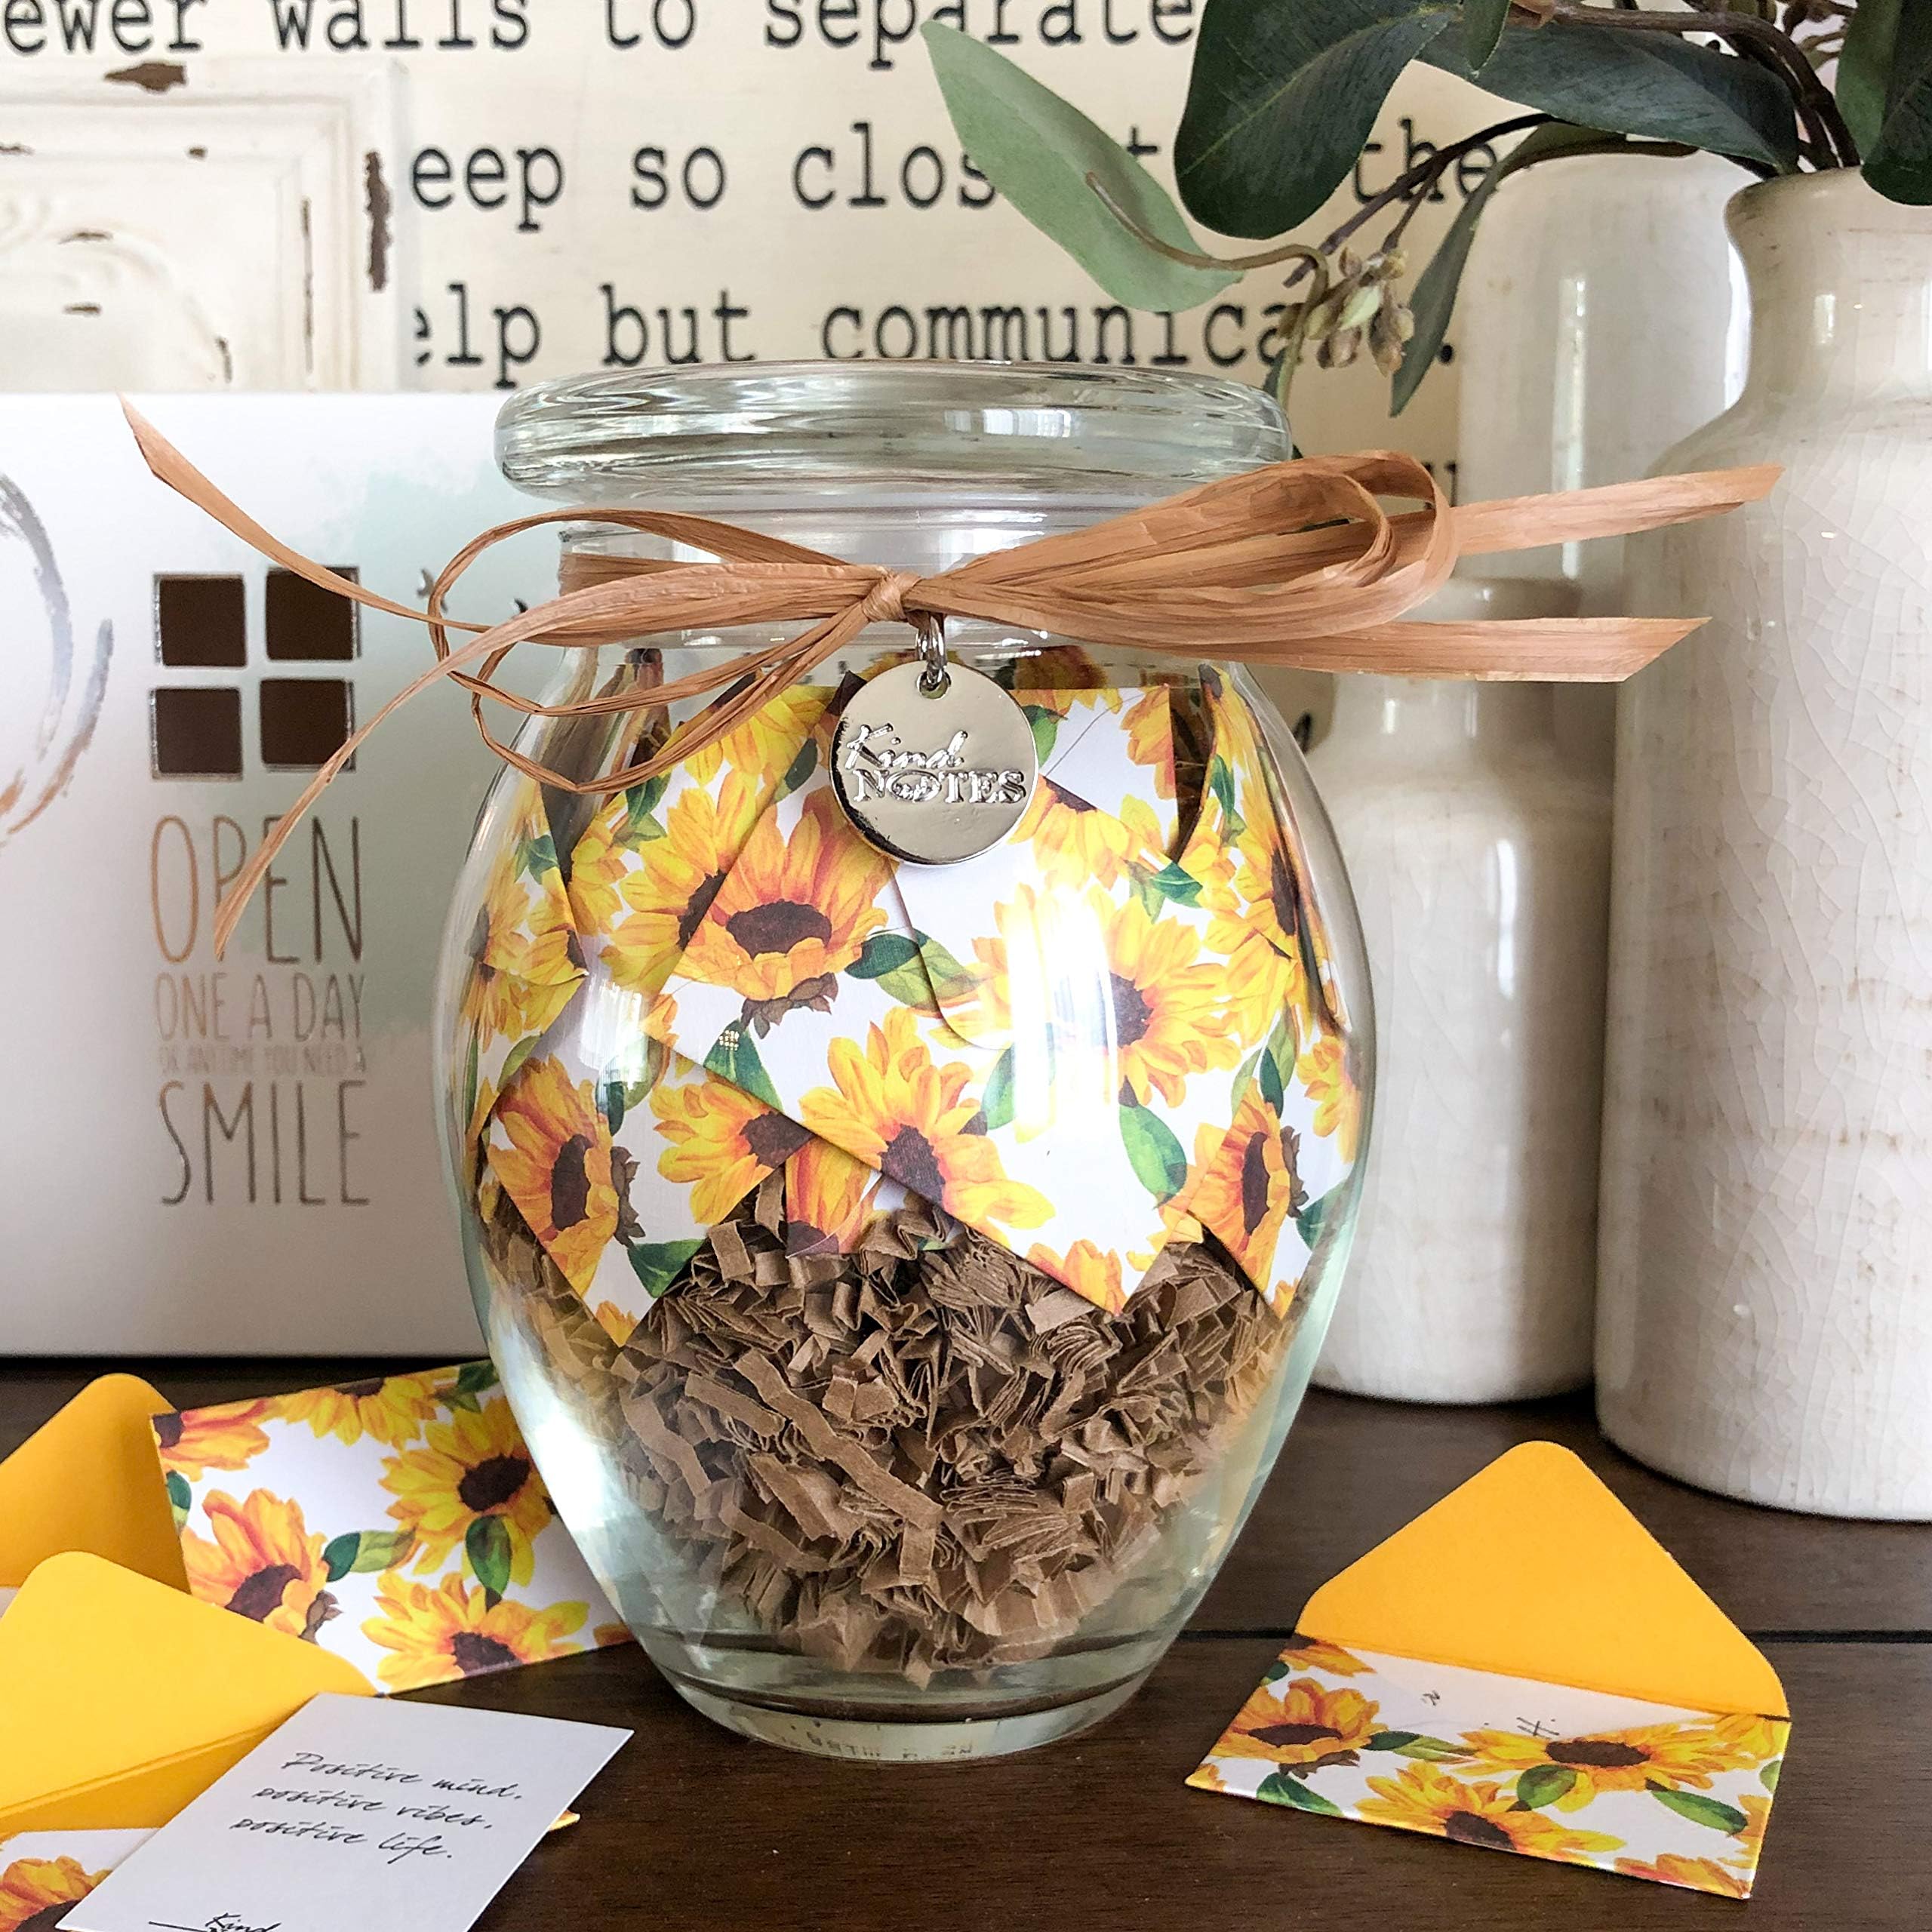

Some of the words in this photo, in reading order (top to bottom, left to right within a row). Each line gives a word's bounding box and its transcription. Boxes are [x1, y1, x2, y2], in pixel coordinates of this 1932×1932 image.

[2, 0, 208, 54] ewer
[268, 0, 533, 54] walls
[604, 0, 697, 50] to
[629, 145, 728, 211] so
[792, 121, 996, 208] clos
[596, 282, 756, 367] but
[844, 722, 969, 771] Kind
[852, 768, 1027, 804] NOTES
[152, 814, 364, 964] OPEN
[155, 971, 230, 1041] ONE
[248, 973, 273, 1039] A
[292, 971, 365, 1042] DAY
[159, 1079, 370, 1206] SMILE
[281, 1752, 423, 1784] Positive
[251, 1787, 387, 1812] positive
[229, 1817, 369, 1845] positive
[377, 1832, 453, 1866] life.
